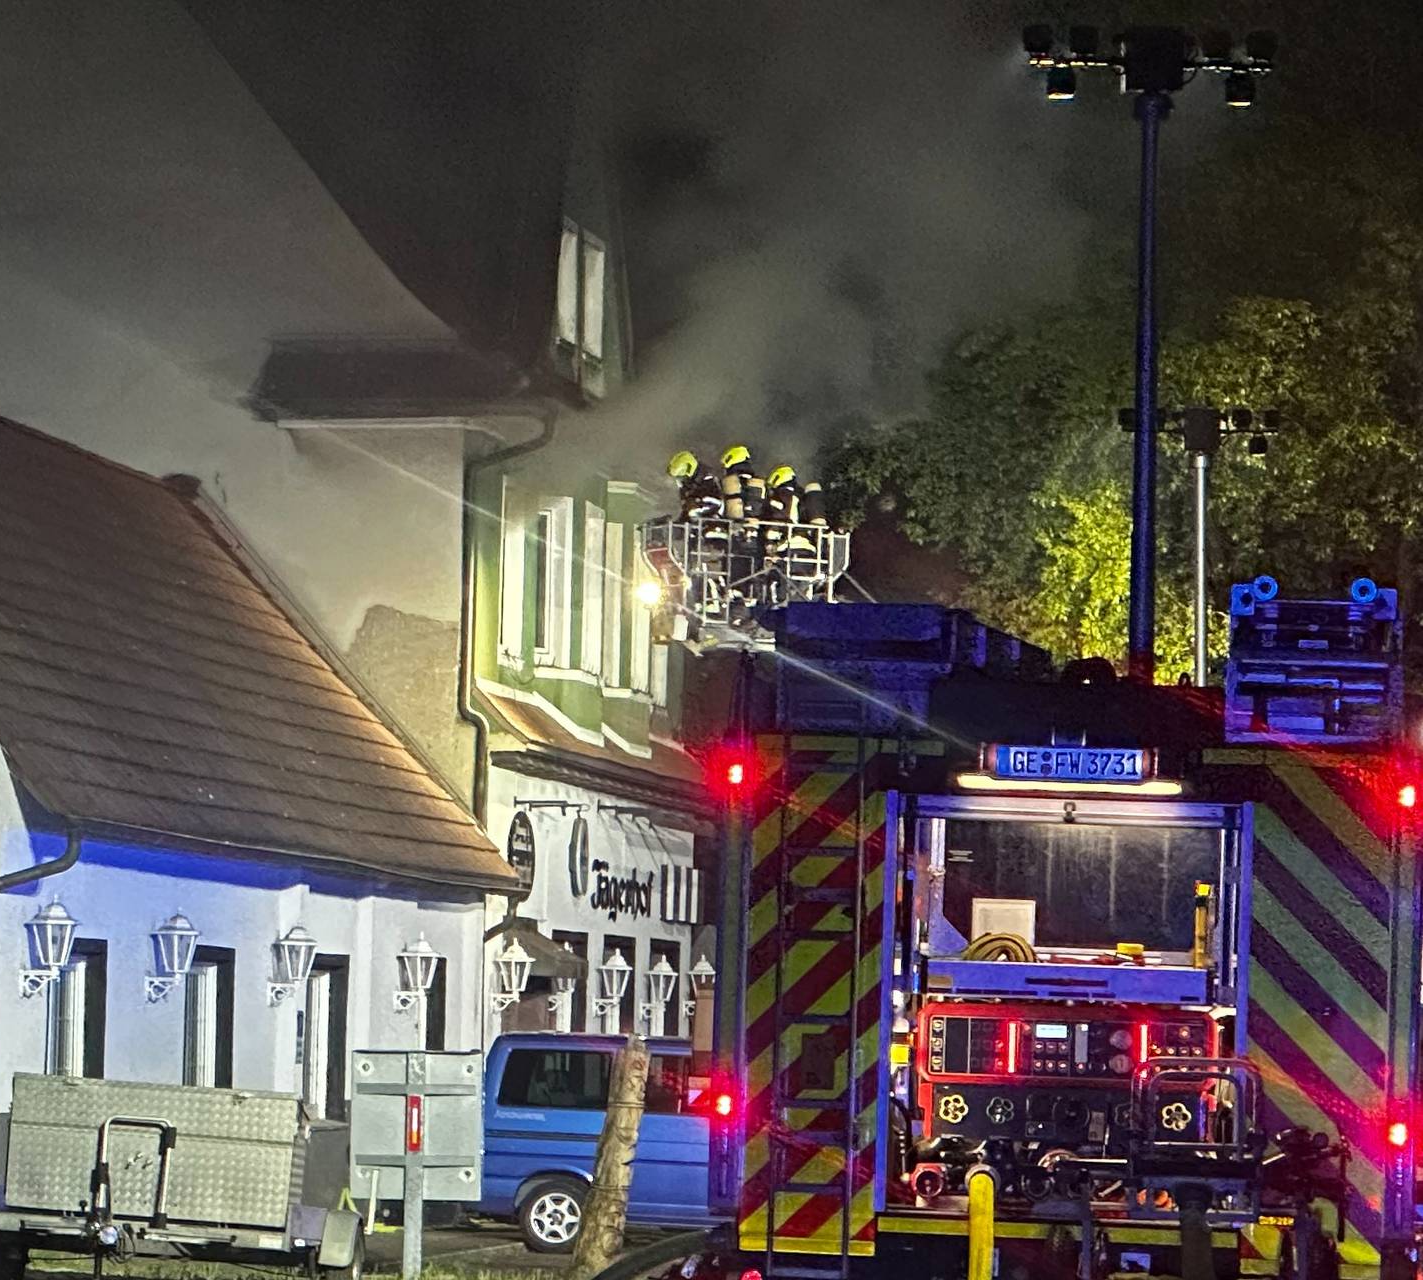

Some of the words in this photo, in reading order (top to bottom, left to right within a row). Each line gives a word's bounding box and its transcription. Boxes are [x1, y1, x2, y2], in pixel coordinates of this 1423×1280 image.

[1012, 750, 1038, 774] GE
[1055, 751, 1083, 775] FW
[1087, 751, 1140, 776] 3731
